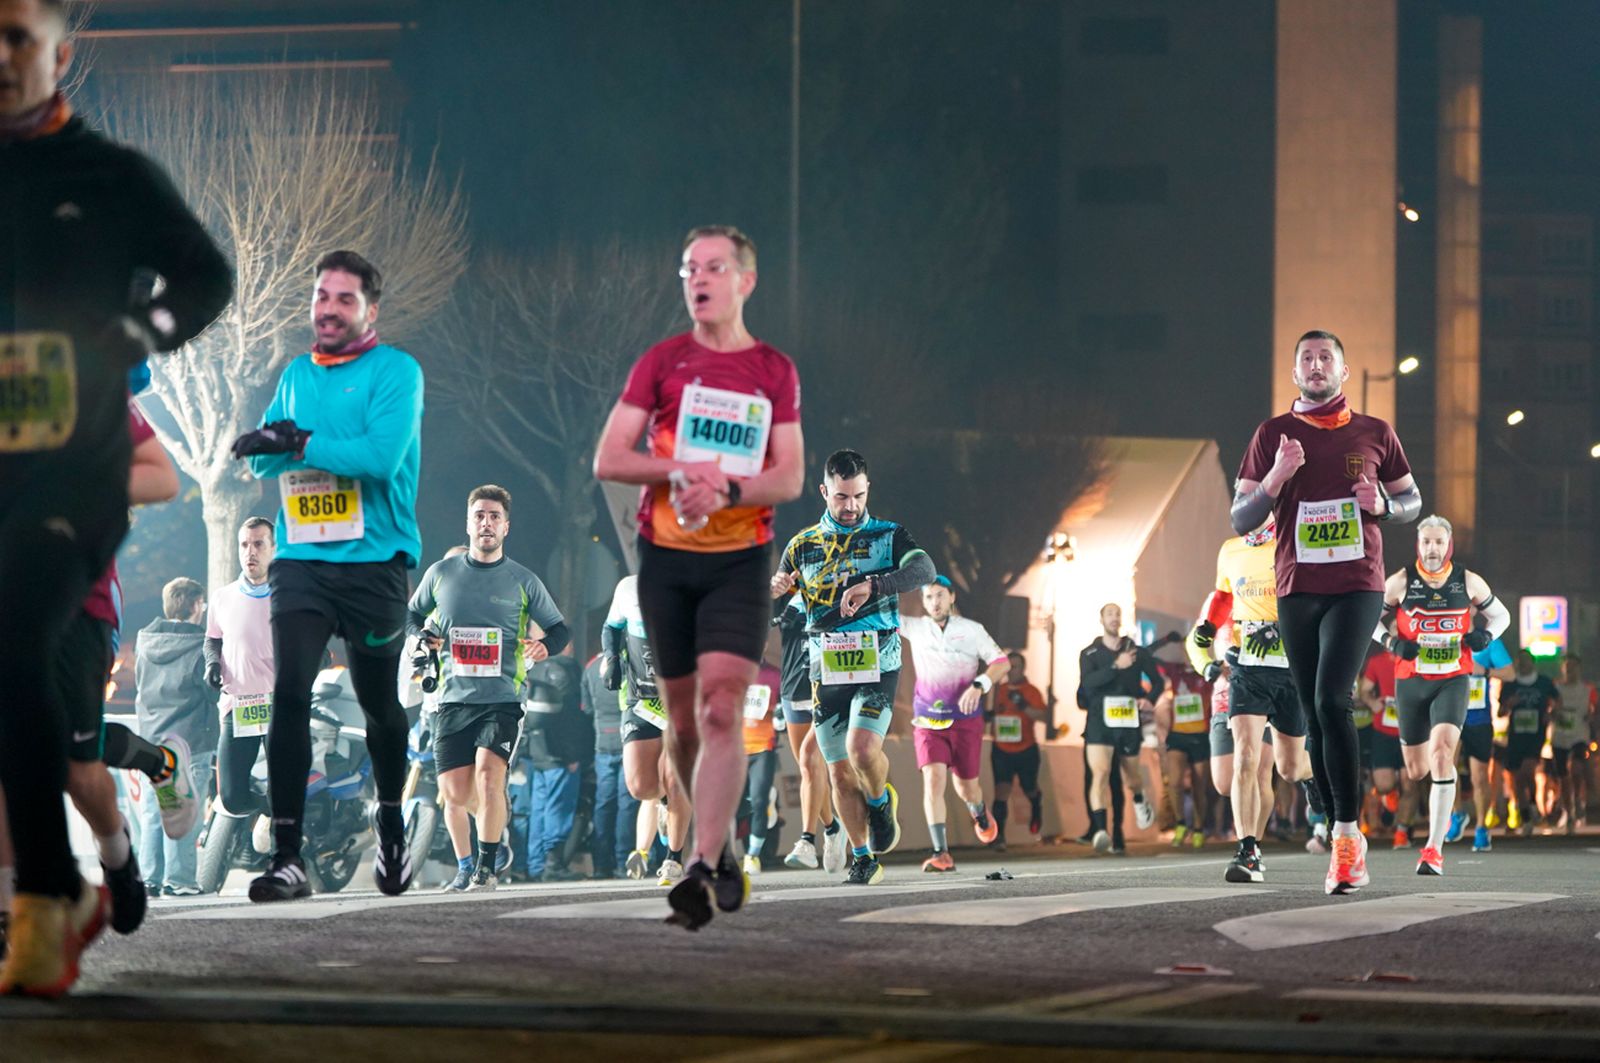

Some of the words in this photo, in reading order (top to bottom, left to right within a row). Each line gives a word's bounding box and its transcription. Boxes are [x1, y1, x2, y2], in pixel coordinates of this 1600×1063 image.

[691, 417, 757, 450] 14006
[298, 492, 347, 517] 8360
[1307, 521, 1350, 542] 2422
[460, 644, 490, 660] 9743
[834, 649, 864, 666] 1172
[1426, 648, 1454, 660] 4557
